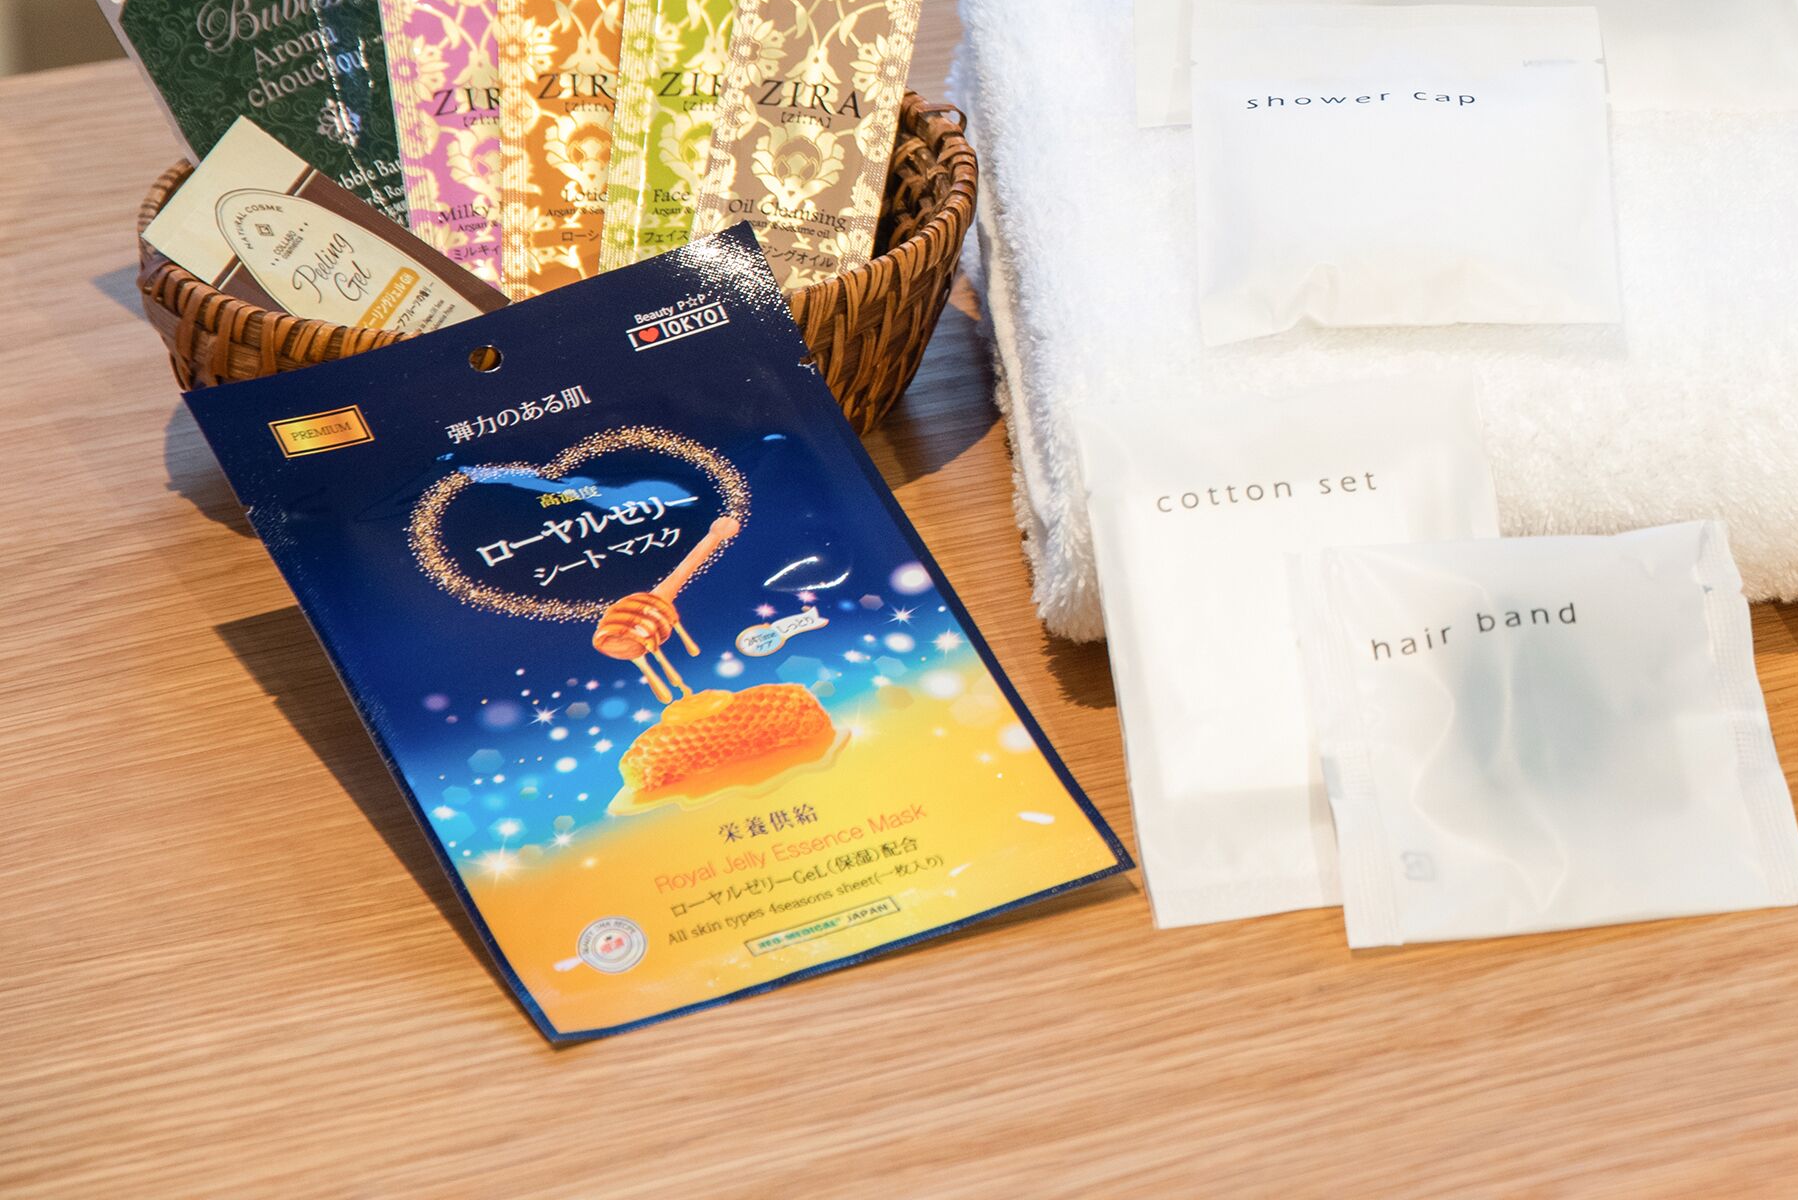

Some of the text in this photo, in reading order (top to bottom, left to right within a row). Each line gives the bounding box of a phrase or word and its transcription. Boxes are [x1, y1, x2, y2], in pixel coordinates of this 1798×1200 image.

[252, 25, 339, 73] Aroma
[758, 79, 862, 120] ZIRA
[1247, 91, 1476, 109] shower cap
[245, 202, 284, 215] COSME
[438, 201, 490, 225] Milky
[653, 188, 690, 203] Face
[728, 198, 847, 233] Oil Cleansing
[643, 230, 690, 244] フェイス
[817, 228, 830, 239] oil
[291, 232, 355, 304] Peeling
[333, 260, 372, 303] Gel
[634, 304, 674, 324] Beauty
[290, 420, 352, 442] PREMIUM
[444, 384, 592, 445] 弾力のある肌
[537, 484, 602, 509] 高濃度
[1157, 470, 1378, 513] cotton set
[476, 495, 700, 567] ローヤルゼリー
[533, 526, 681, 587] シートマスク
[1371, 602, 1577, 660] hair band
[718, 803, 819, 844] 栄養供給
[654, 802, 927, 895] Royal Jelly Essence Mask
[668, 931, 688, 946] All
[690, 919, 721, 939] skin
[725, 908, 765, 930] types
[768, 889, 833, 916] 4seasons
[848, 903, 888, 923] JAPAN
